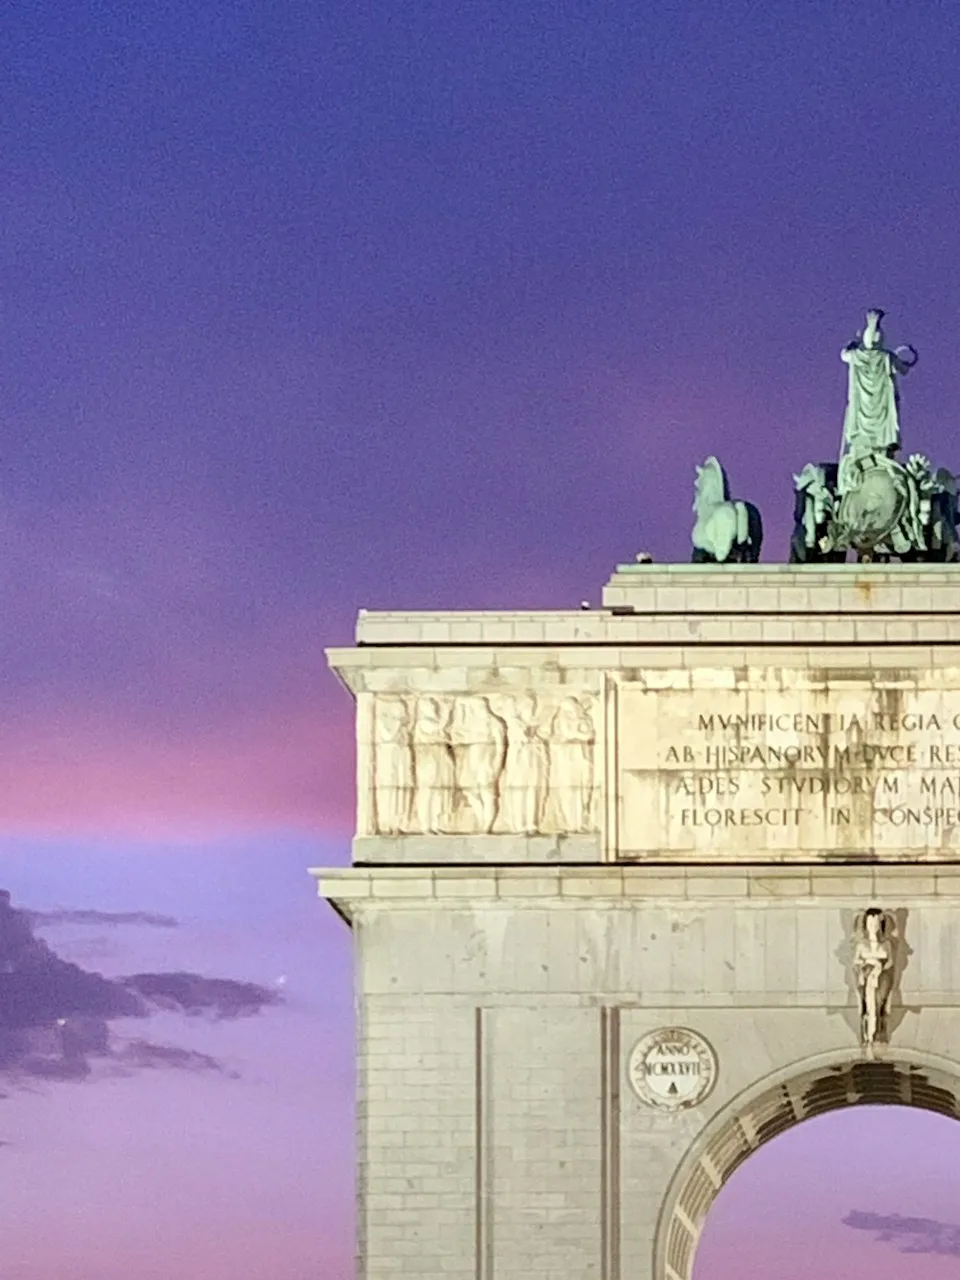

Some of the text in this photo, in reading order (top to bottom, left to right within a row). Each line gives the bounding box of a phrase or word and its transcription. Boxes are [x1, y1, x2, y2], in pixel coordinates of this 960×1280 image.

[873, 712, 941, 731] REGIA
[681, 808, 804, 826] FLORESCIT
[831, 808, 850, 826] IN
